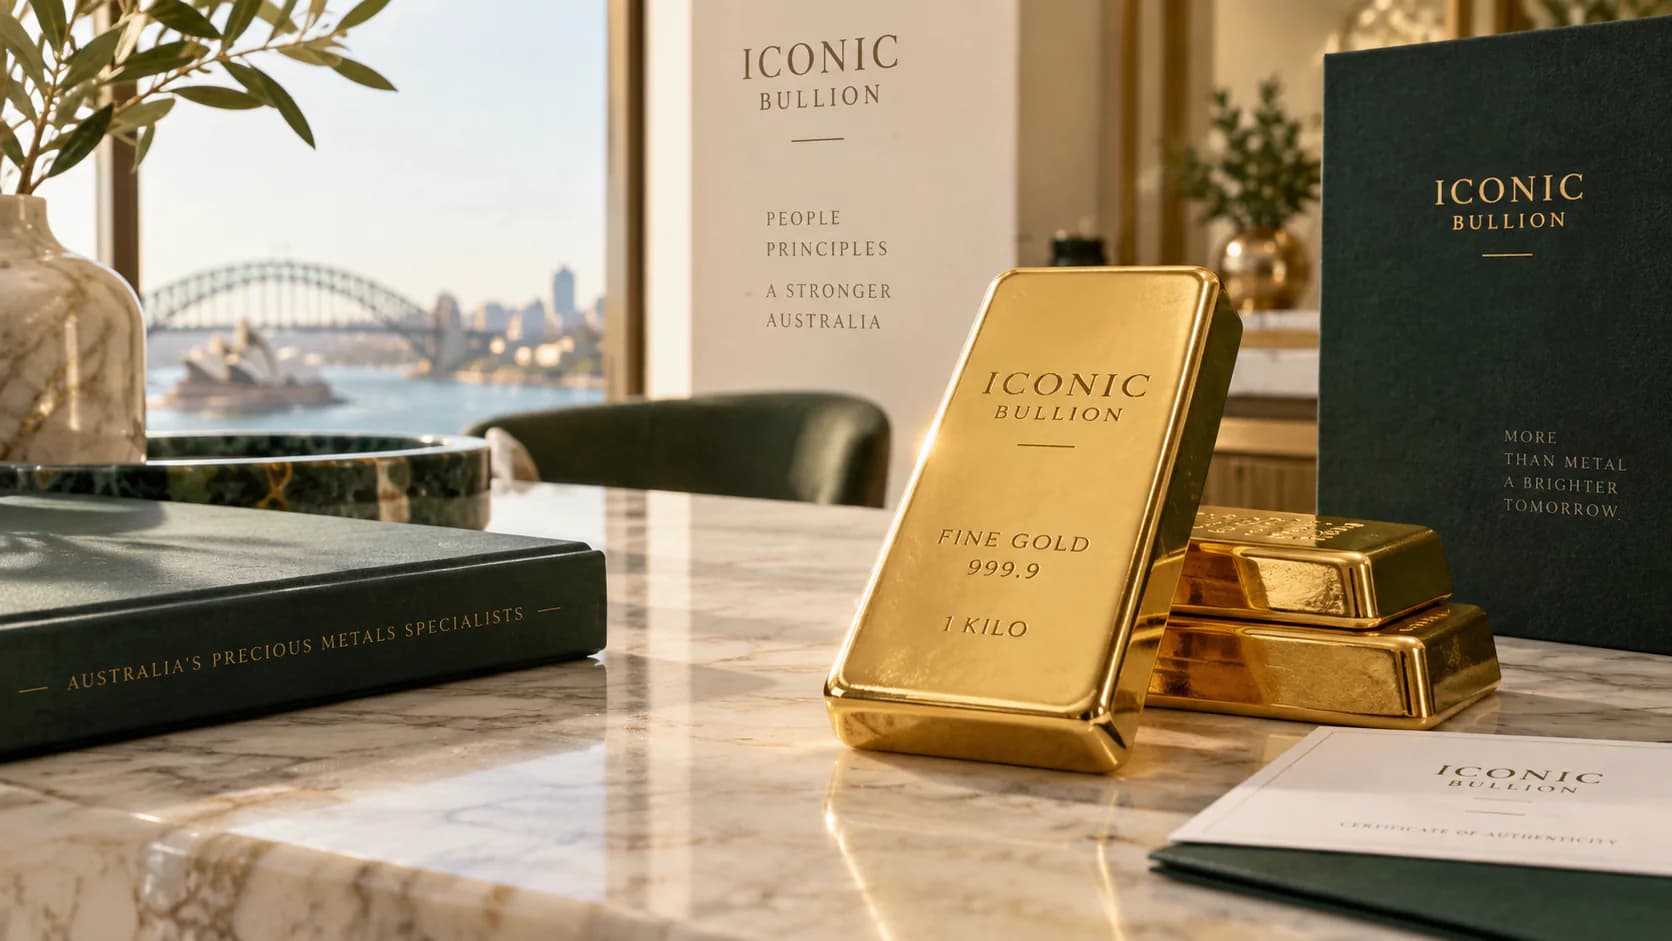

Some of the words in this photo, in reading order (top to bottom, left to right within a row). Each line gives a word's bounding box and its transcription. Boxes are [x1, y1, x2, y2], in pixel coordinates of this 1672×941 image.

[743, 34, 898, 80] ICONIC
[759, 84, 880, 111] BULLION
[1434, 173, 1584, 206] ICONIC
[766, 210, 841, 226] PEOPLE
[1452, 211, 1566, 231] BULLION
[766, 240, 888, 257] PRINCIPLES
[766, 283, 777, 299] A
[786, 283, 891, 299] STRONGER
[766, 313, 881, 330] AUSTRALIA
[982, 371, 1151, 398] ICONIC
[993, 404, 1123, 423] BULLION
[1504, 430, 1557, 444] MORE
[1504, 452, 1555, 467] THAN
[1565, 456, 1627, 472] METAL
[1503, 476, 1514, 488] A
[1523, 476, 1618, 495] BRIGHTER
[937, 528, 1001, 548] FINE
[1011, 533, 1091, 553] GOLD
[967, 559, 1040, 579] 999.9
[943, 615, 954, 633] 1
[962, 617, 1029, 638] KILO
[67, 655, 202, 692] AUSTRALIA'S
[212, 638, 313, 669] PRECIOUS
[321, 625, 398, 651] METALS
[404, 606, 525, 639] SPECIALISTS
[1436, 764, 1605, 785] ICONIC
[1448, 779, 1579, 794] BULLION
